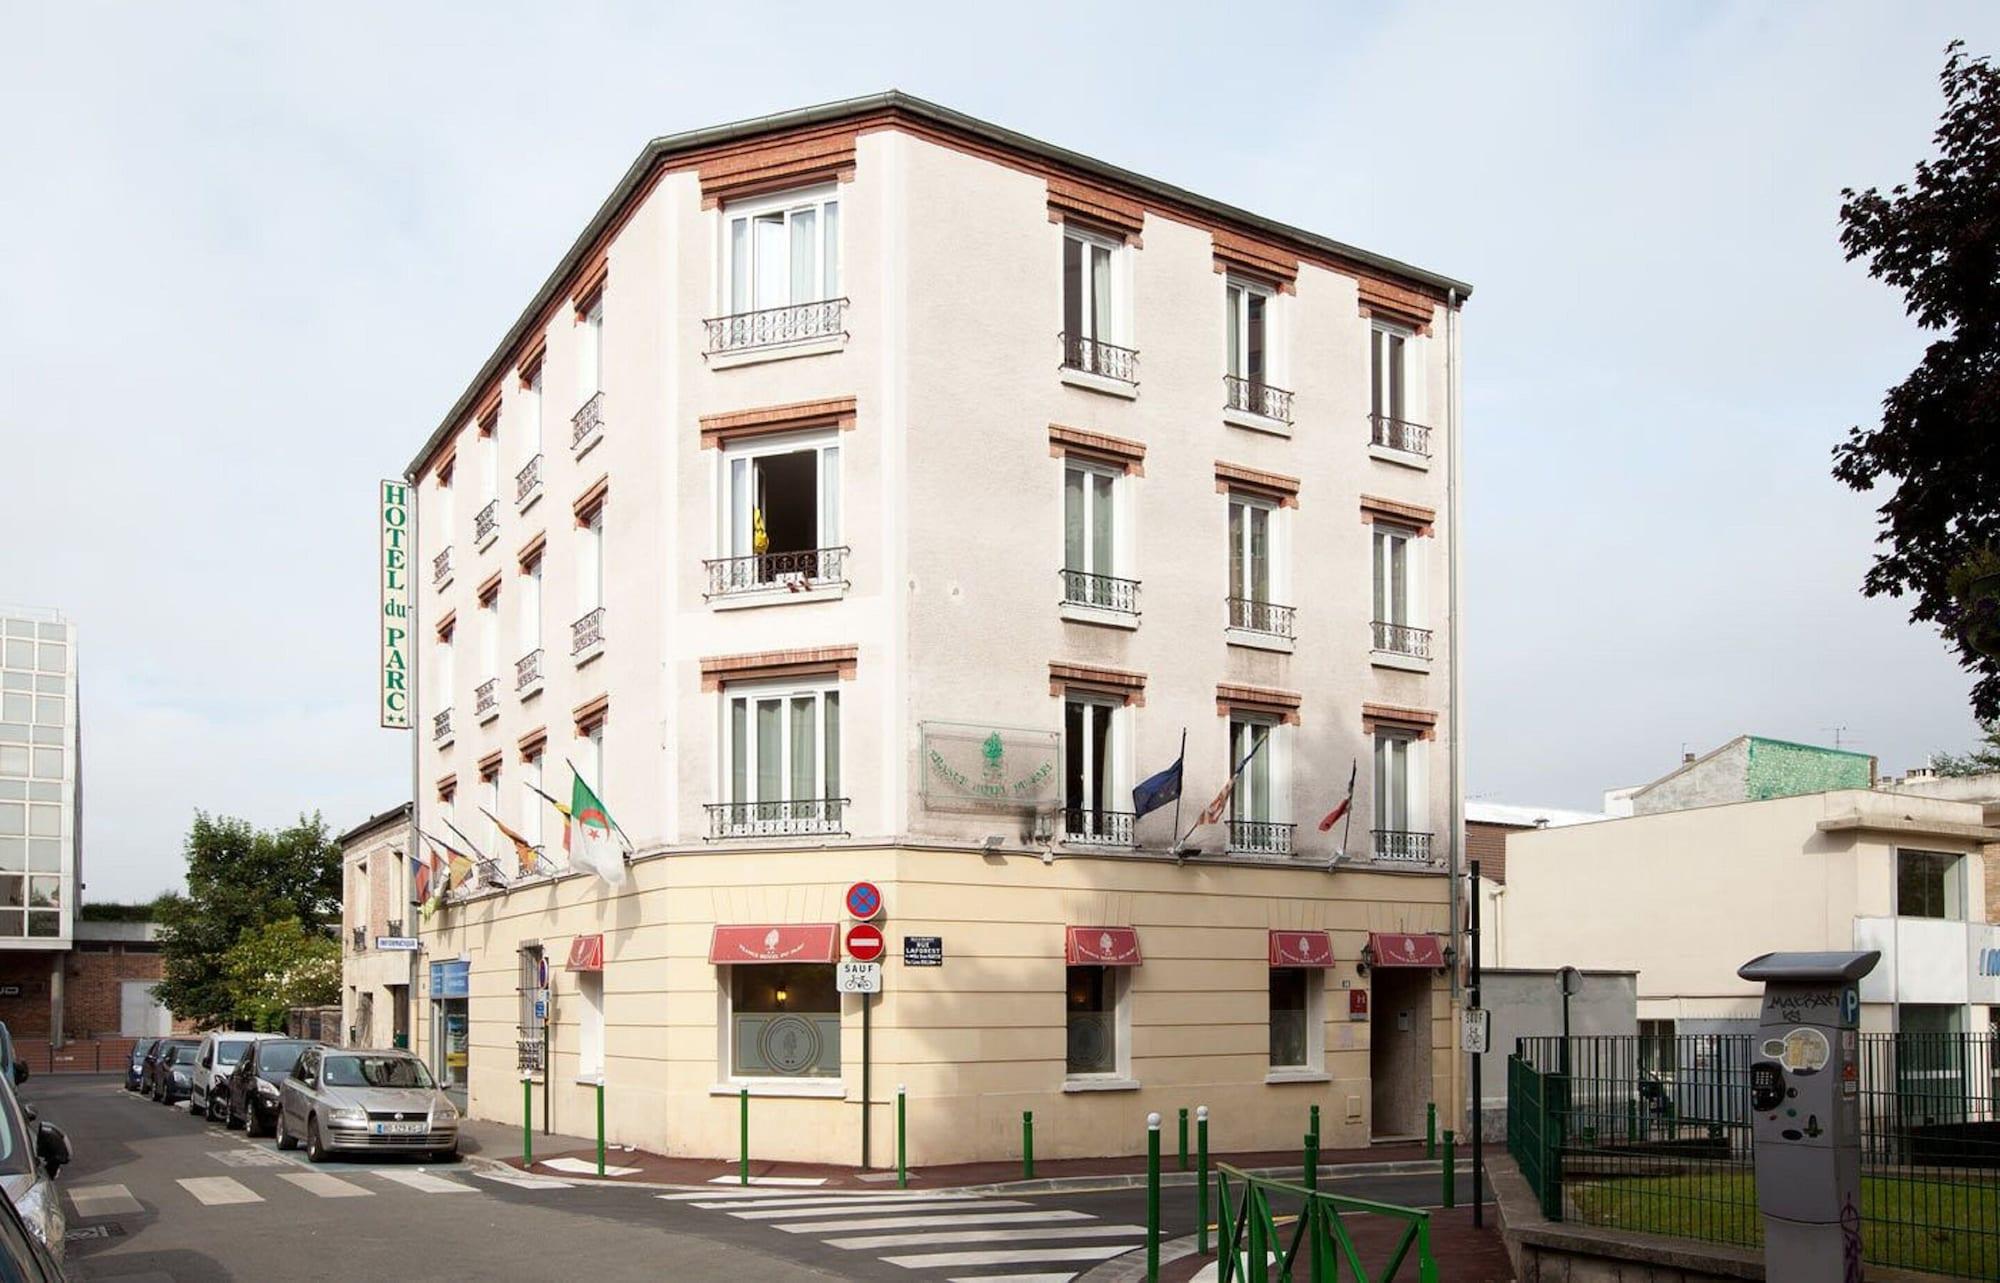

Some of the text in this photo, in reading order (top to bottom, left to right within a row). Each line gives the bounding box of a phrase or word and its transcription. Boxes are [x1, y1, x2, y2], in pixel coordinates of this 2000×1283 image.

[384, 484, 406, 711] HOTEL du PARC
[844, 964, 873, 973] SAUF
[1847, 989, 1858, 1023] P
